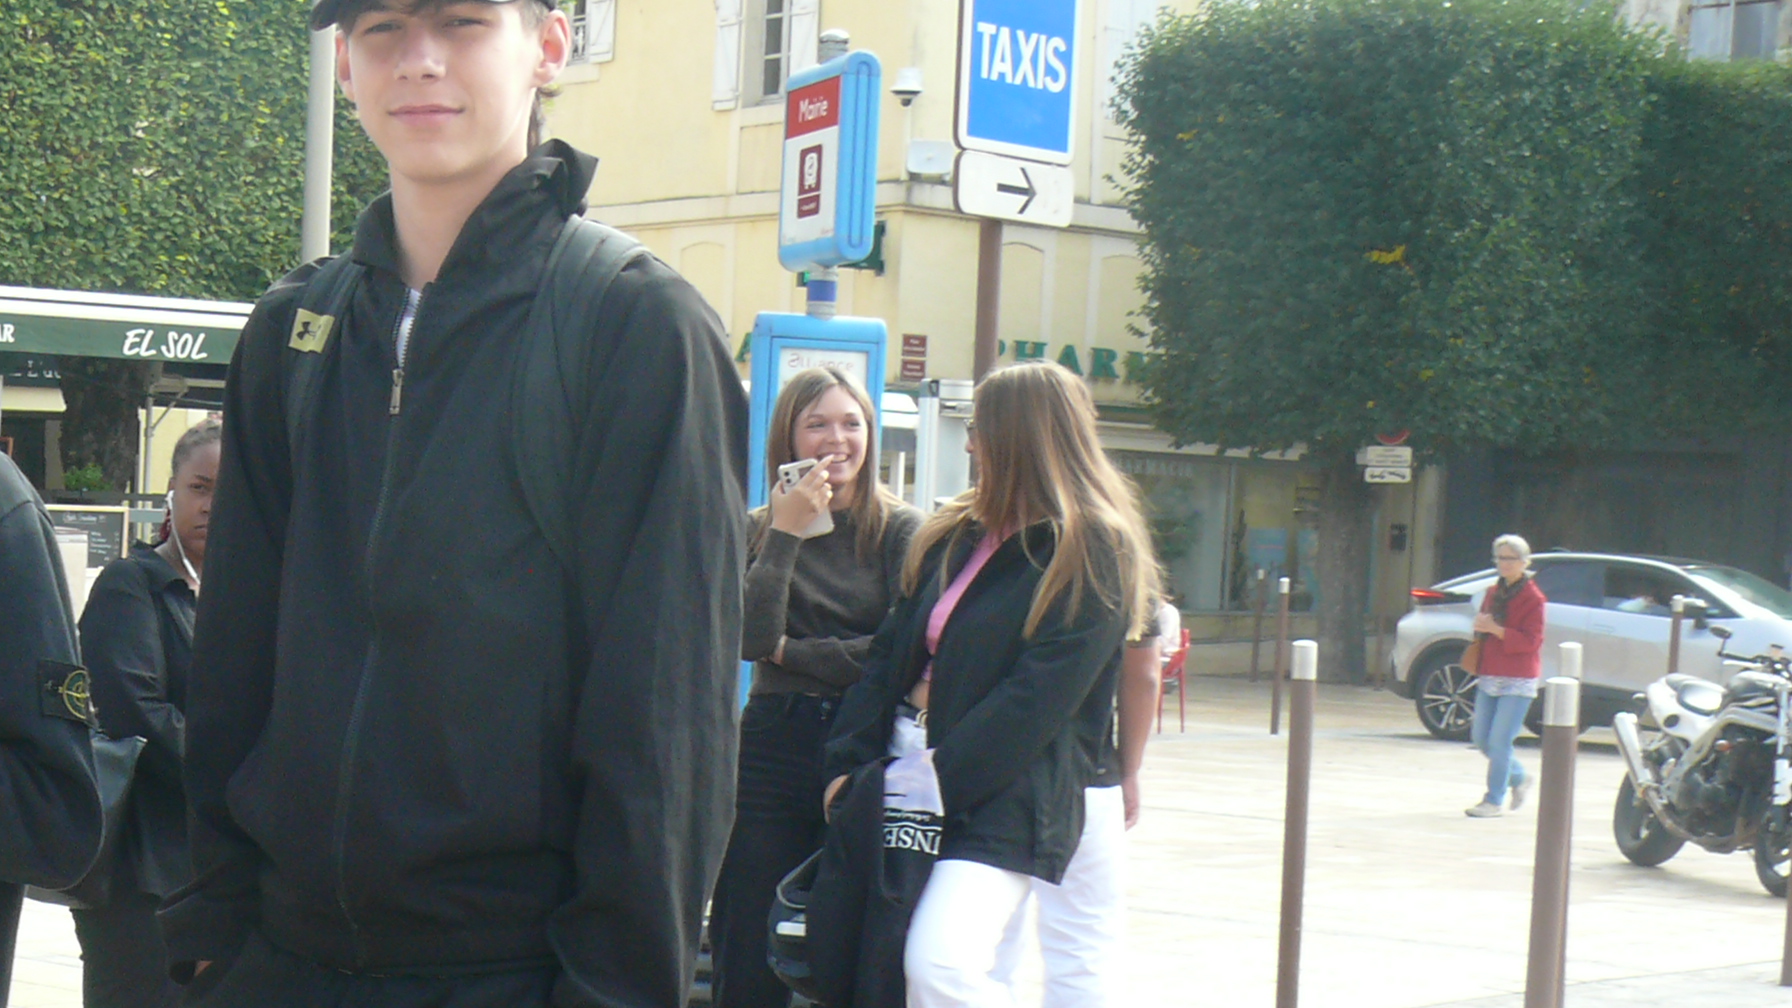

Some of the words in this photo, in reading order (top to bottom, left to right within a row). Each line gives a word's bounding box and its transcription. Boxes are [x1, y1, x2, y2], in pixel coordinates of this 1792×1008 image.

[977, 22, 1067, 93] TAXIS
[798, 96, 829, 123] Mairie
[122, 329, 157, 357] EL
[160, 331, 208, 360] SOL
[998, 340, 1146, 381] HAR
